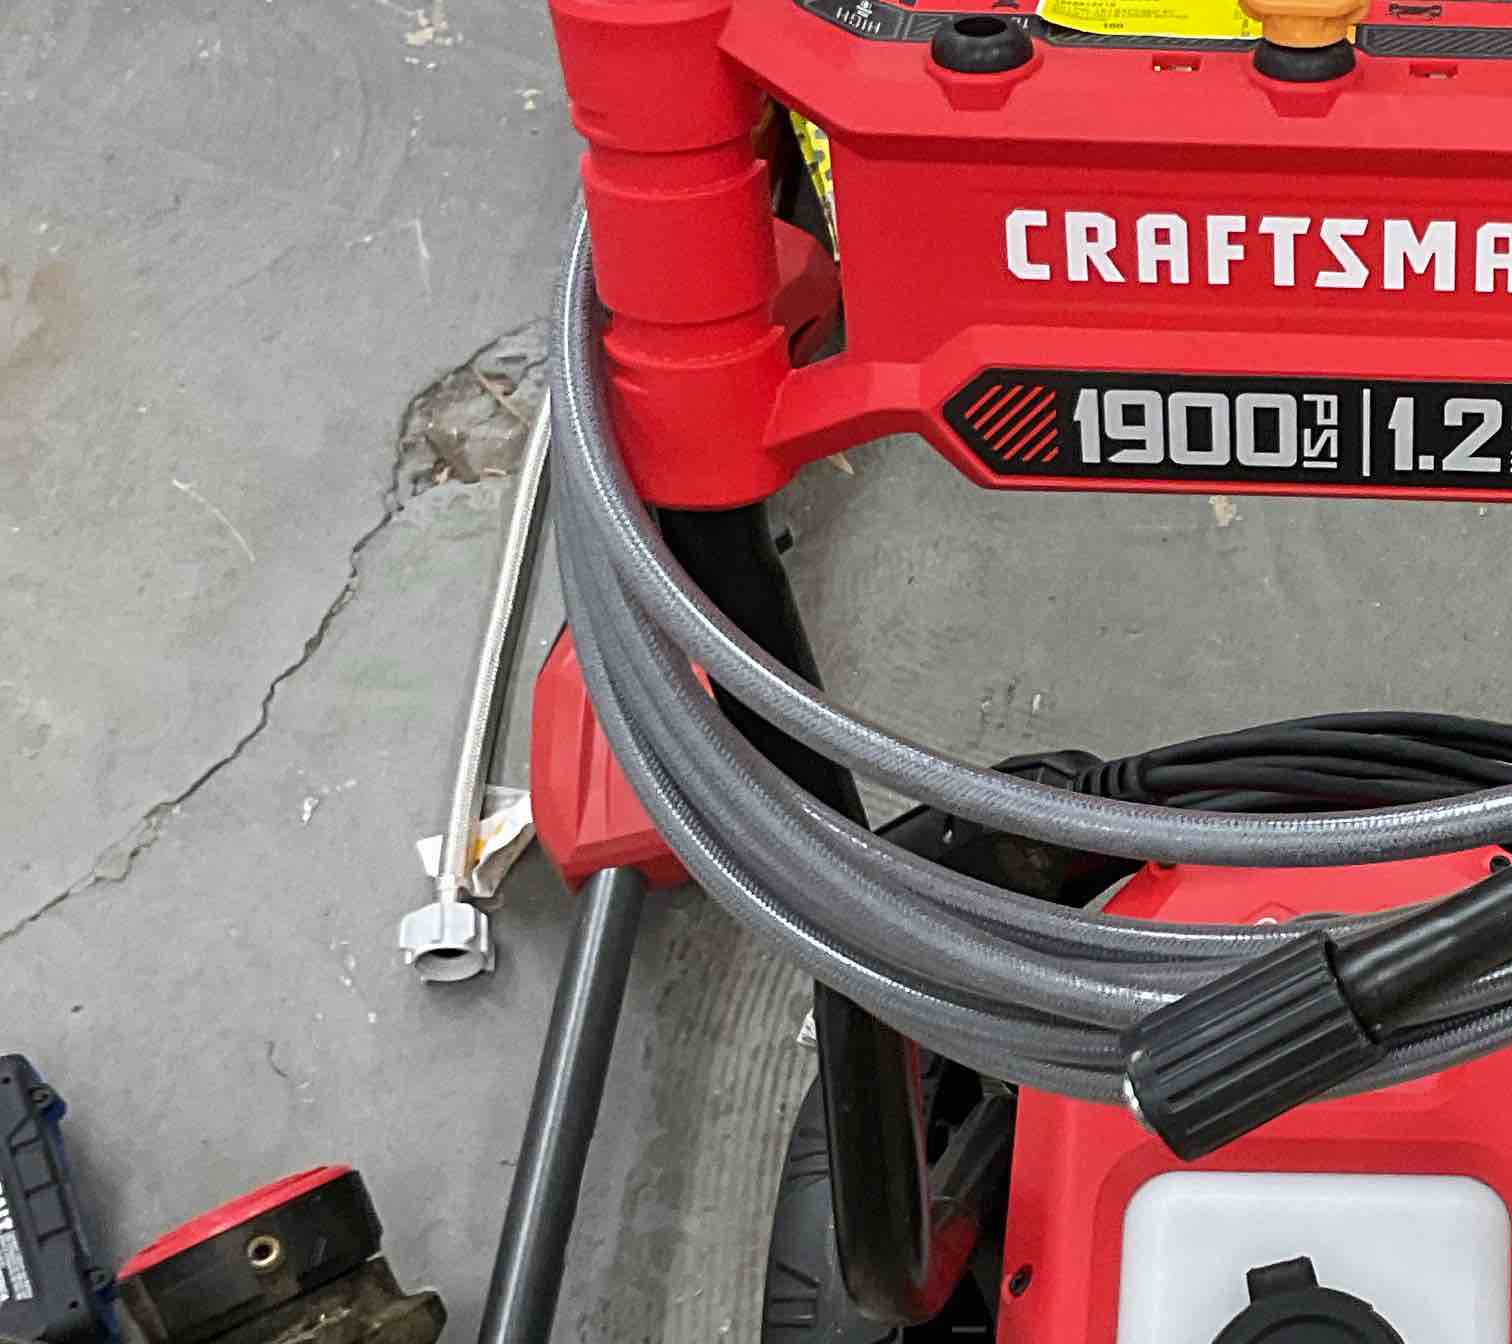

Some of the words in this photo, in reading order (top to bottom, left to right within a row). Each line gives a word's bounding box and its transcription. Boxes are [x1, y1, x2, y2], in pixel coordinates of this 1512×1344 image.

[836, 6, 882, 35] HIGH
[1073, 387, 1298, 468] 1900
[1303, 393, 1339, 470] PSI
[1387, 396, 1503, 474] 1.2
